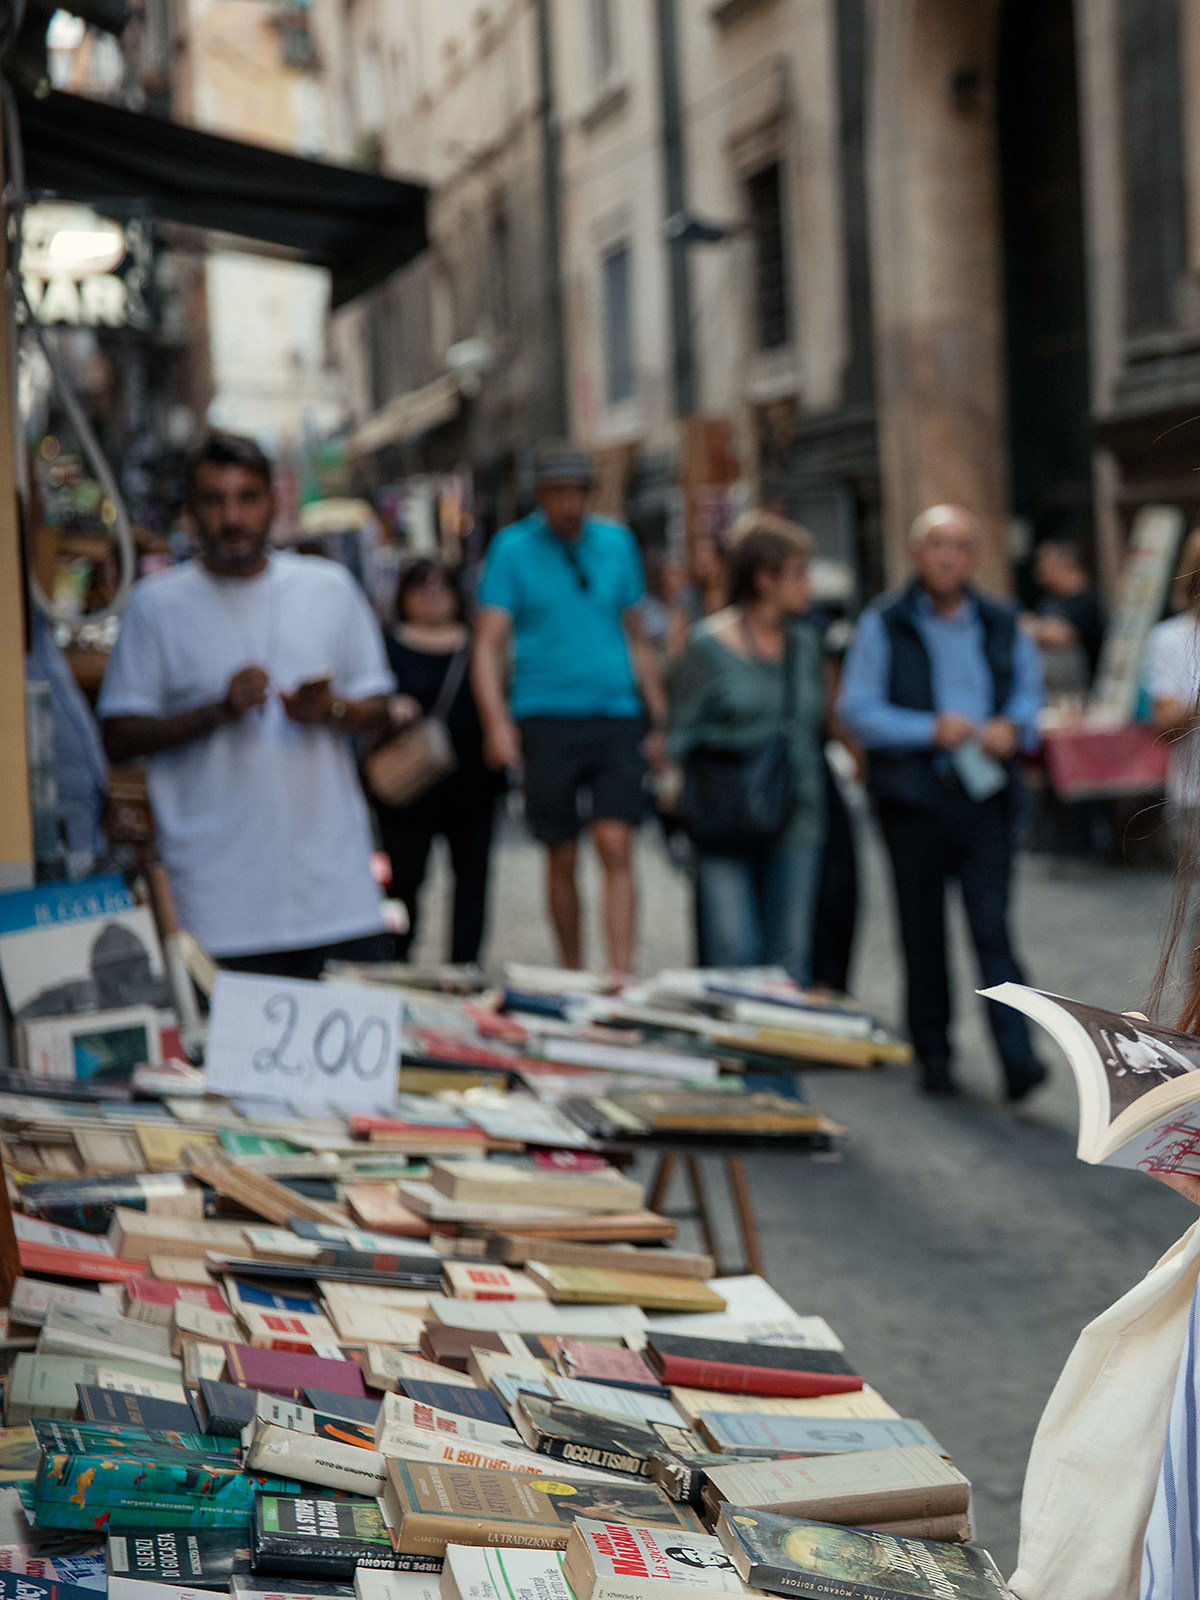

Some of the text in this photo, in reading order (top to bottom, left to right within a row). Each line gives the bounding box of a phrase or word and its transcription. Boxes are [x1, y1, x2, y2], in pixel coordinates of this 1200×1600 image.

[315, 1459, 334, 1468] FOTO
[443, 1446, 454, 1460] IL
[562, 1443, 640, 1473] OCCULTISMO
[121, 1499, 153, 1507] margaret
[155, 1502, 194, 1510] mazzantini
[450, 1472, 483, 1511] LEGGENDA
[294, 1498, 317, 1535] LA STIRPE
[317, 1500, 340, 1538] DI RAGHU
[135, 1538, 156, 1567] SILENZI
[488, 1532, 500, 1543] LA
[500, 1533, 556, 1549] TRADIZIONE
[589, 1531, 617, 1557] ANDRÉ
[604, 1524, 649, 1578] MALRAUX
[157, 1532, 181, 1577] DI GIOCASTA
[357, 1558, 396, 1569] RAGHU
[398, 1561, 410, 1570] DI
[636, 1528, 671, 1580] La speranza
[781, 1577, 815, 1590] EDITORE
[817, 1584, 852, 1597] MORANO
